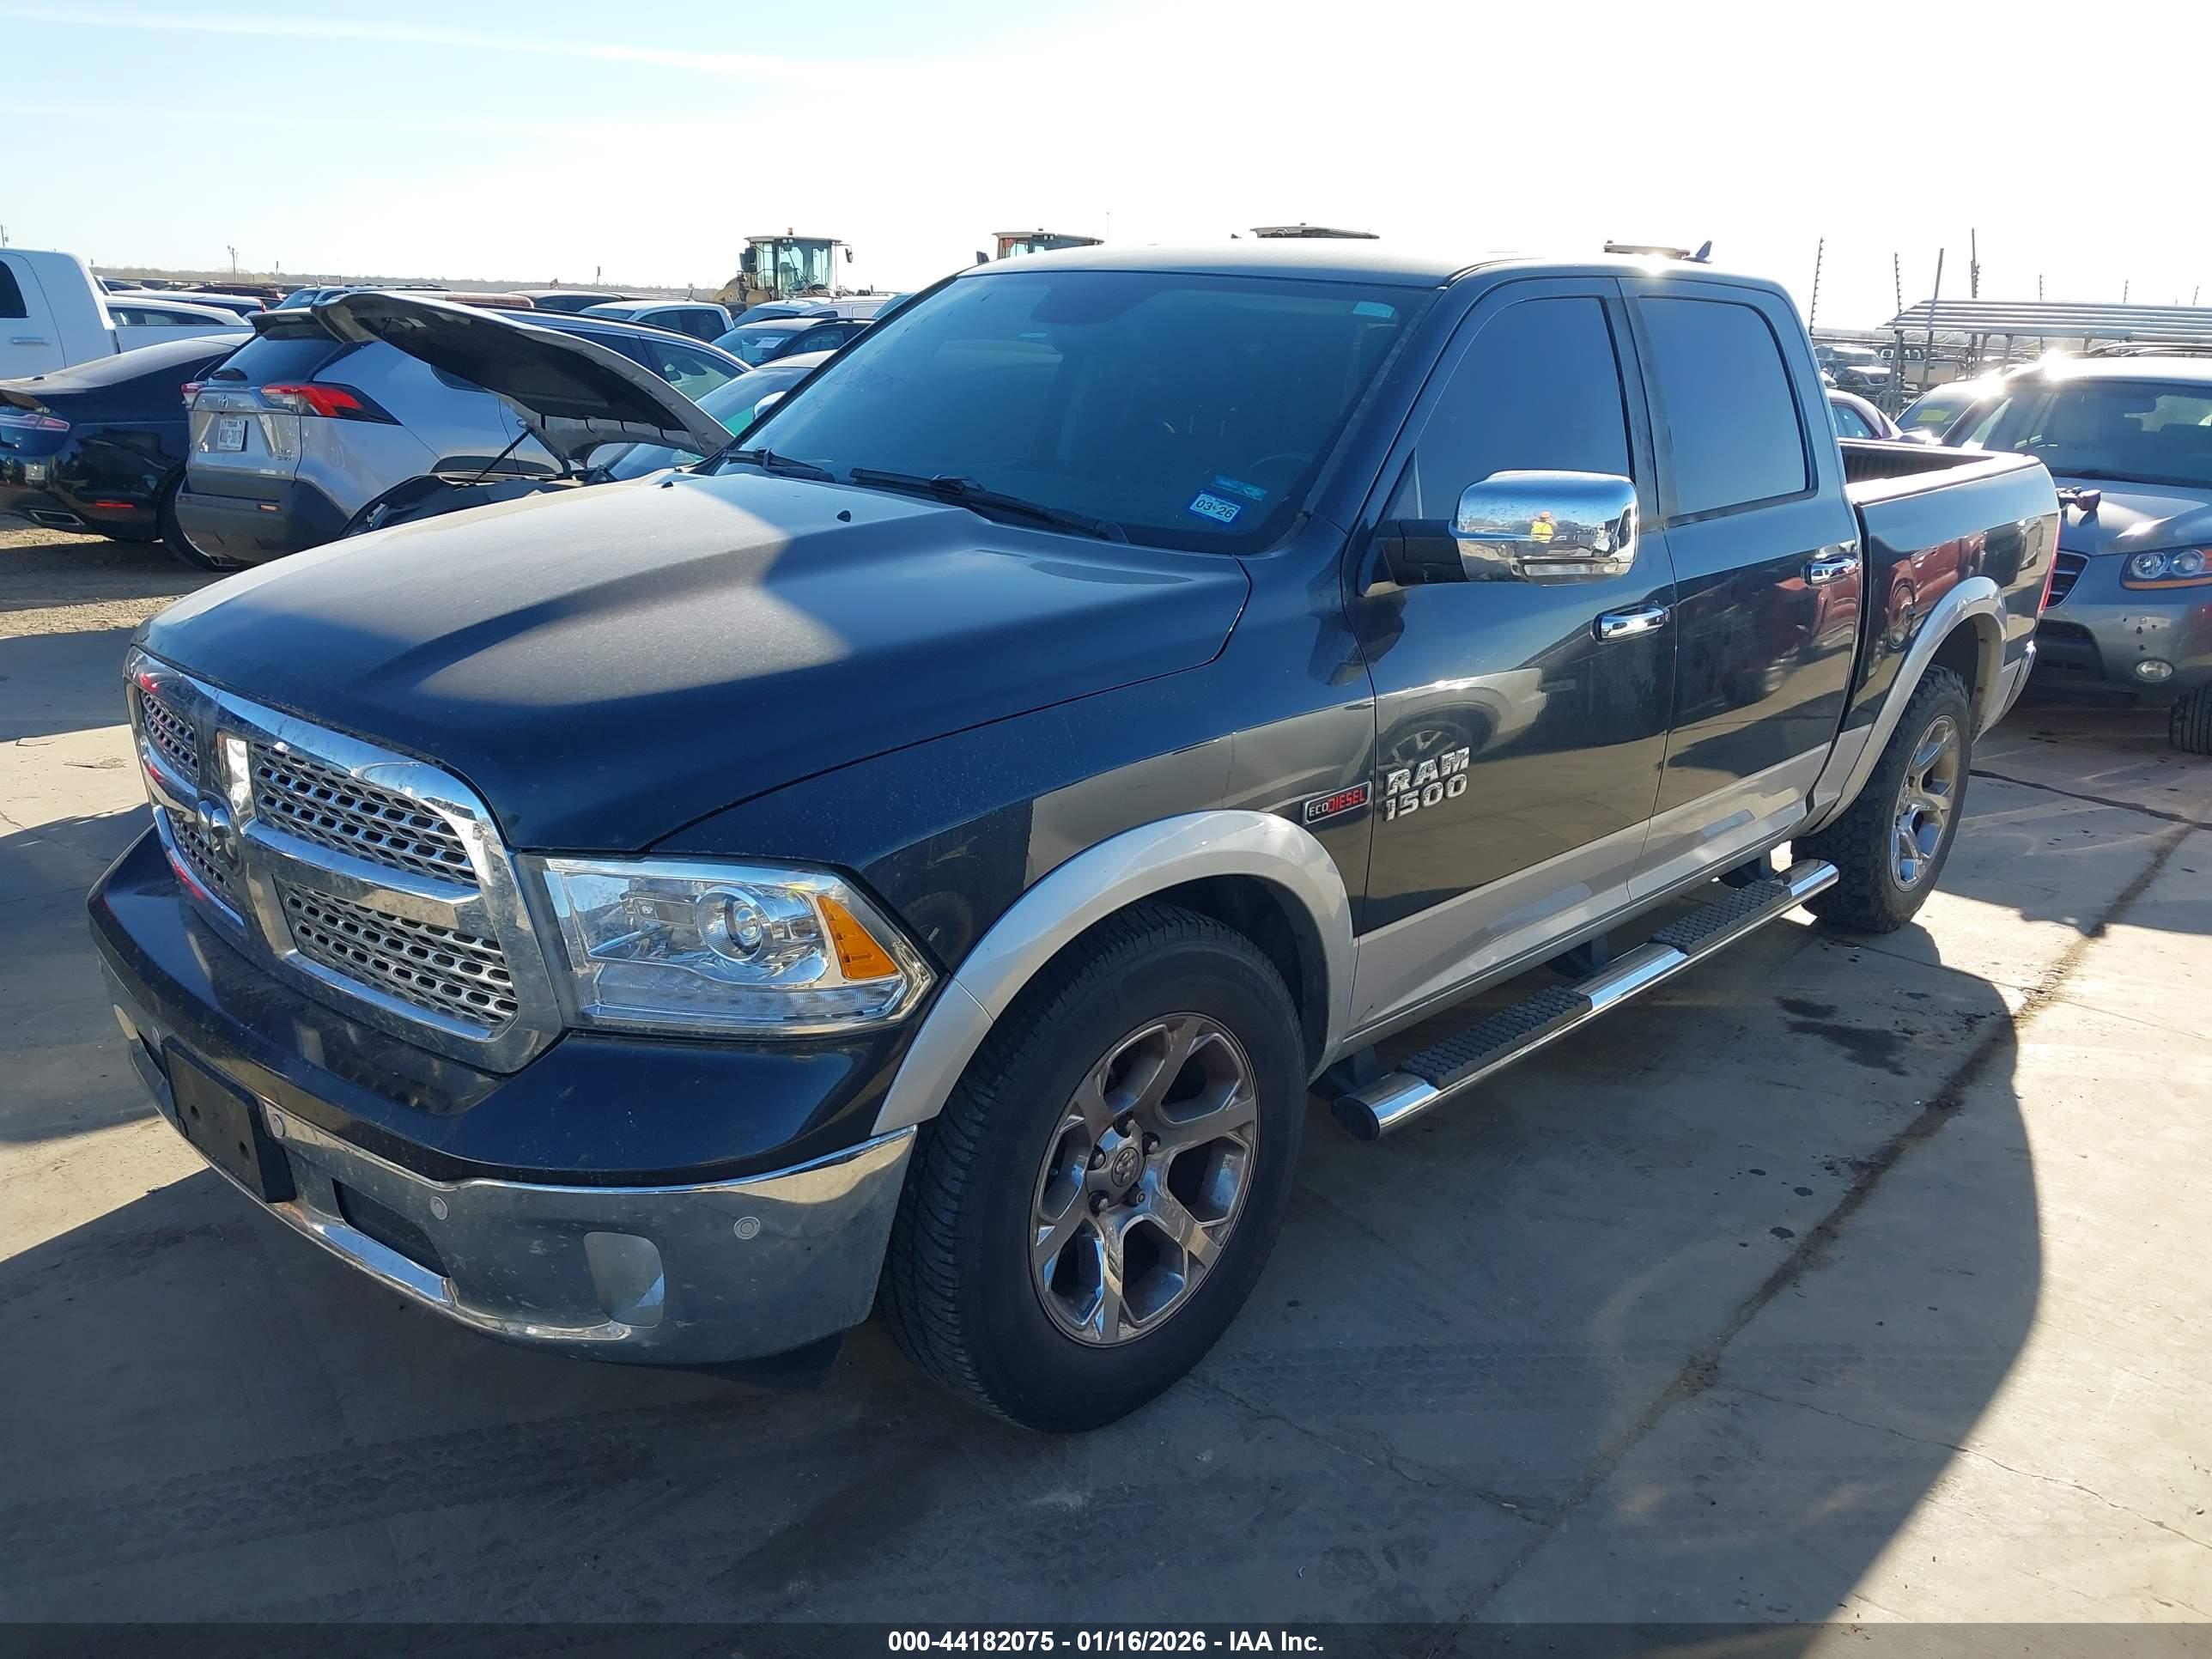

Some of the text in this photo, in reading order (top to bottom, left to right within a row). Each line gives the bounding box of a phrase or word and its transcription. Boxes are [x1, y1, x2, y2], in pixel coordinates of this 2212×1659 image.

[1195, 499, 1235, 518] 03 26
[1386, 746, 1470, 797] RAM
[1385, 773, 1468, 823] 1500
